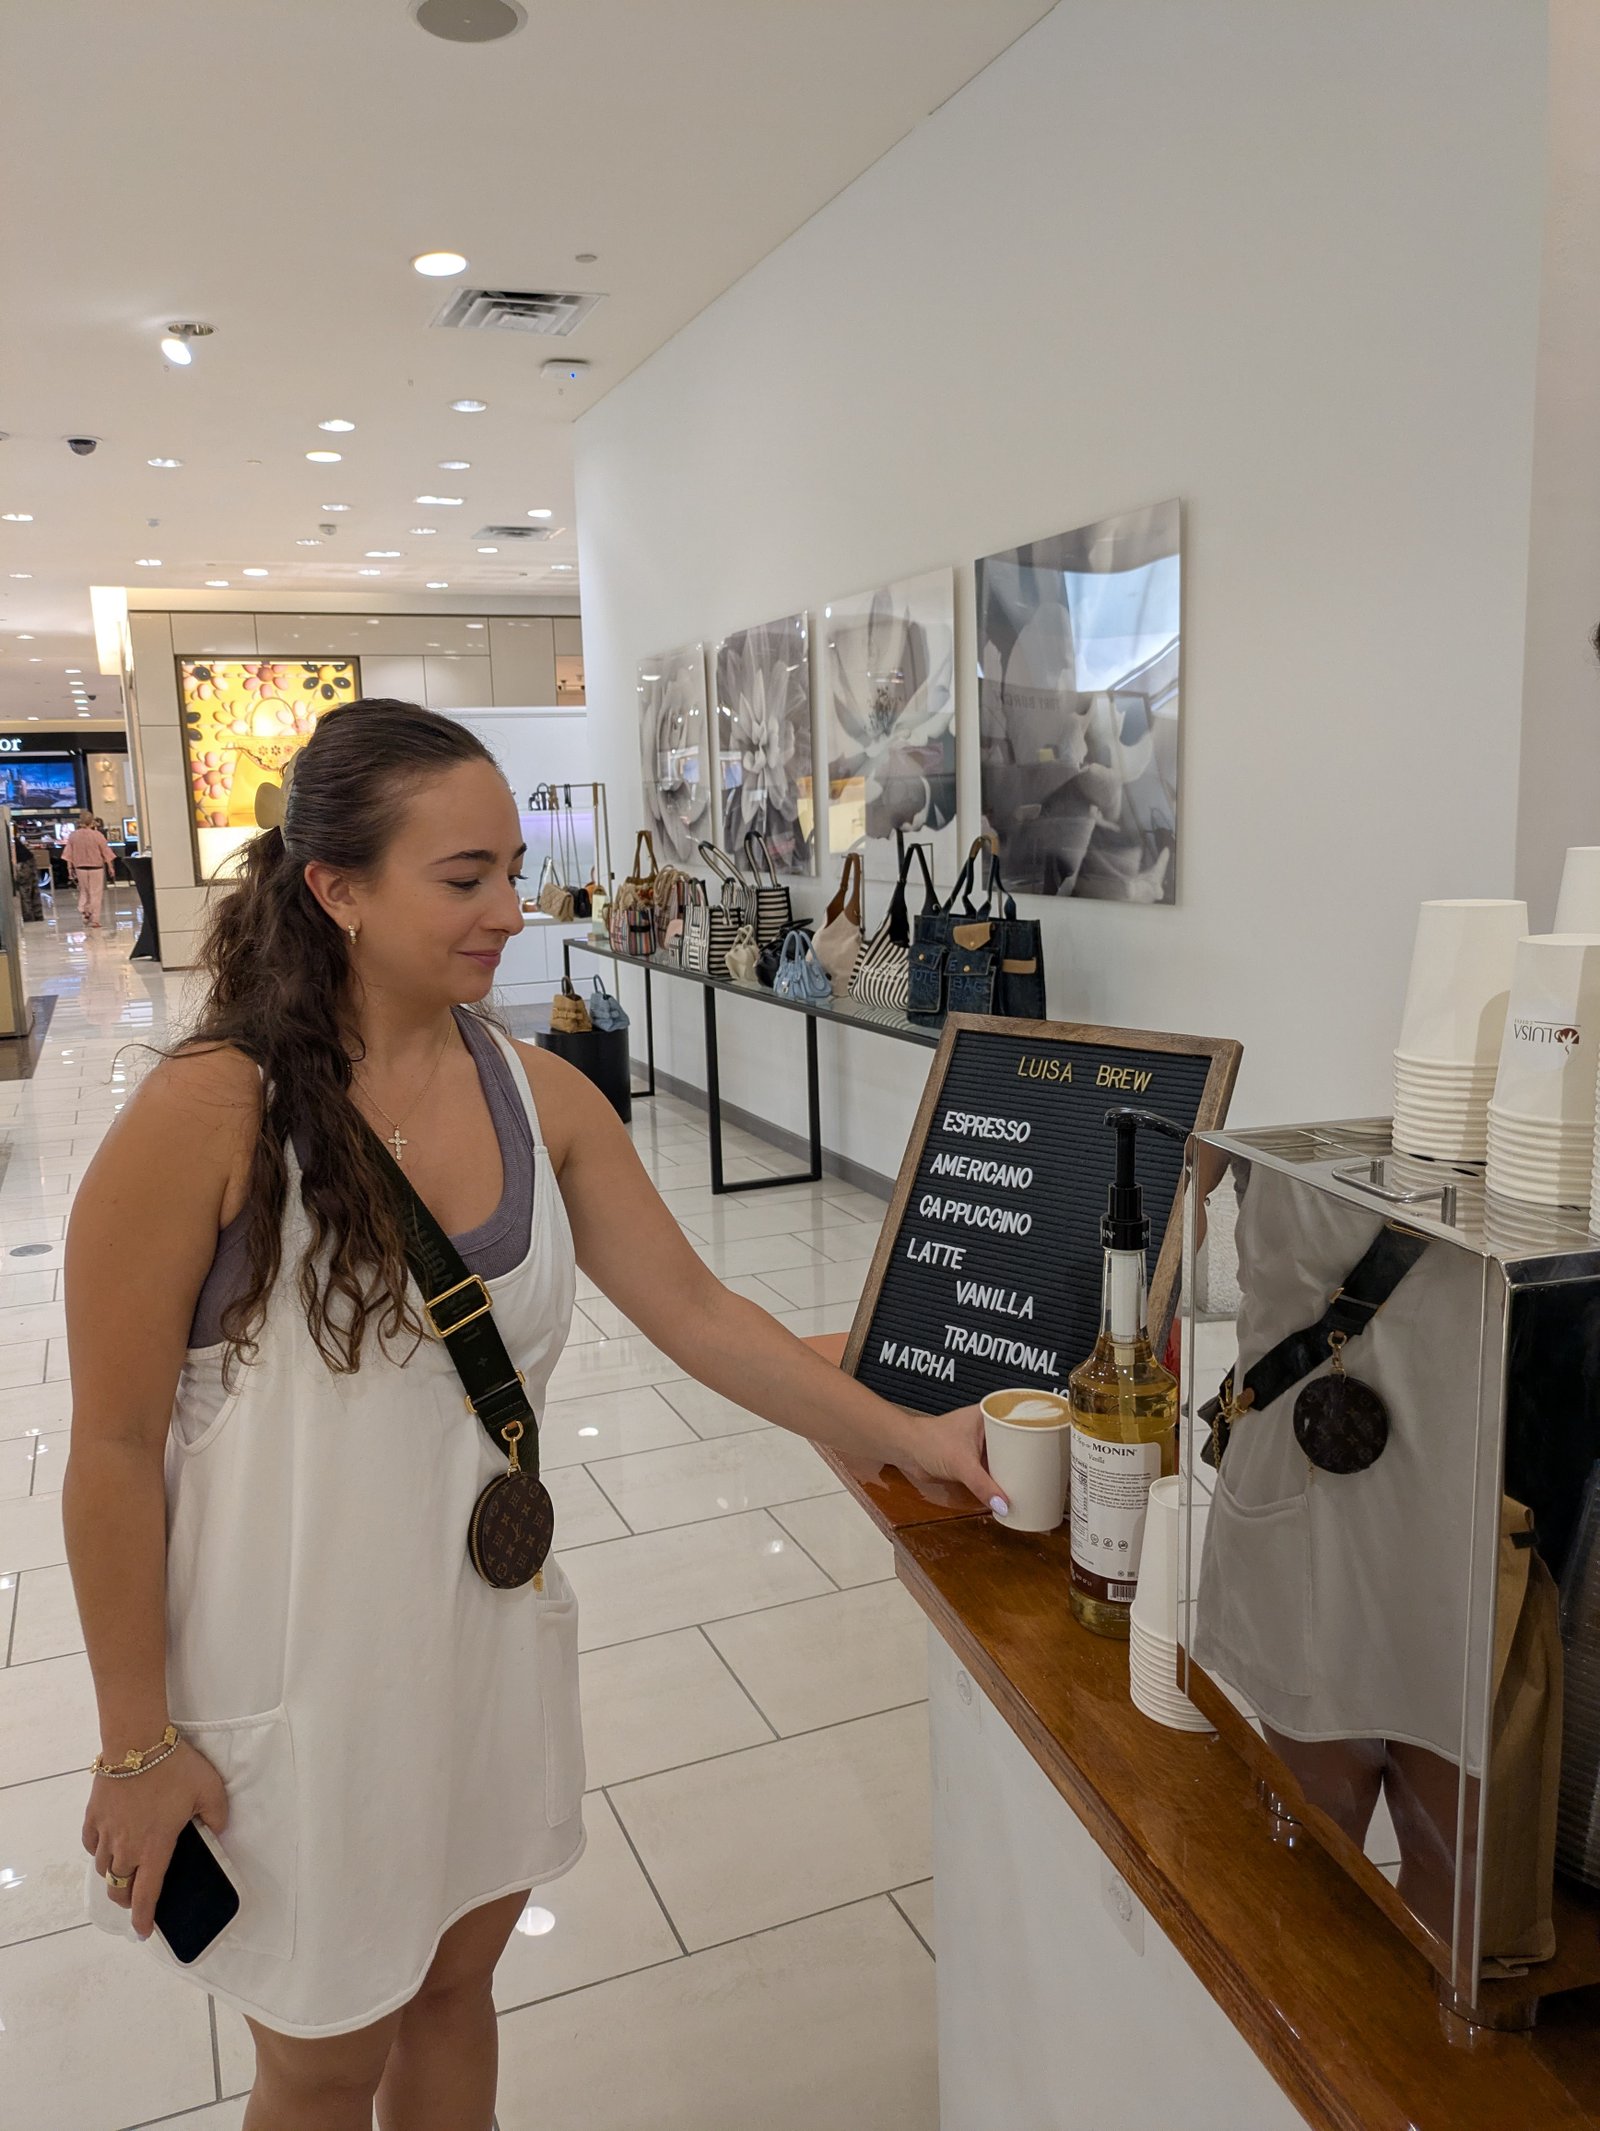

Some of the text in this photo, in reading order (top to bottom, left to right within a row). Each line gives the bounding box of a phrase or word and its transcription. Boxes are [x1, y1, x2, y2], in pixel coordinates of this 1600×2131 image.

[1513, 1024, 1552, 1044] LUISA
[1017, 1056, 1153, 1094] LUISA BREW
[942, 1110, 1031, 1143] ESPRESSO
[929, 1153, 1033, 1190] AMERICANO
[919, 1194, 1032, 1236] CAPPUCCINO
[906, 1237, 967, 1270] LATTE
[956, 1280, 1034, 1320] VANILLA
[878, 1341, 955, 1383] MATCHA
[943, 1324, 1060, 1377] TRADITIONAL
